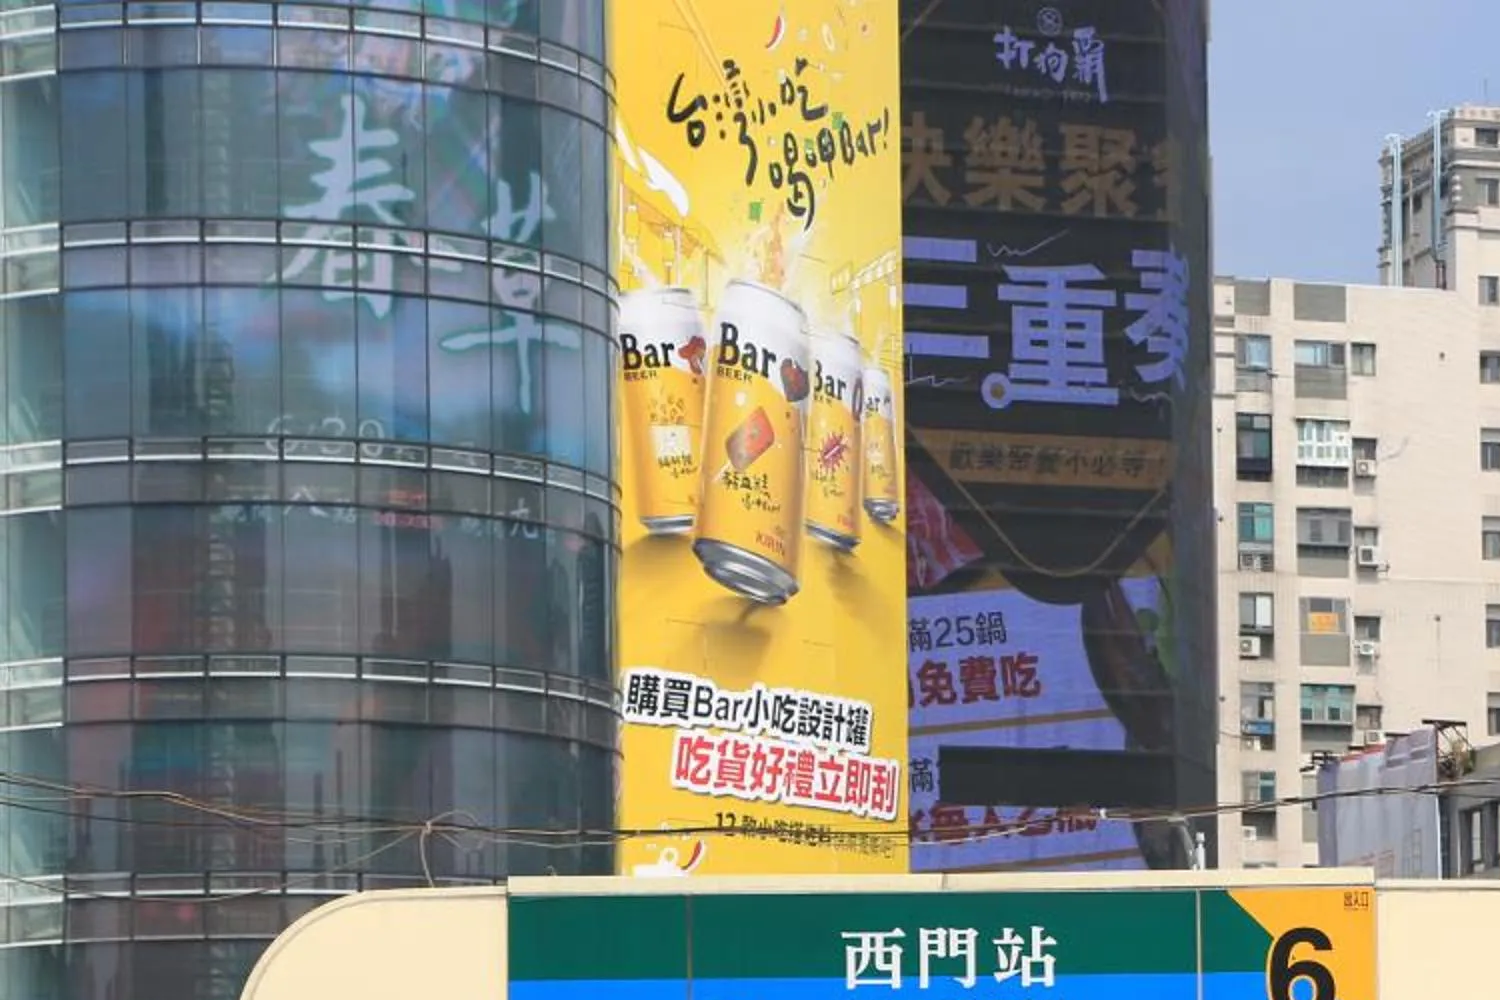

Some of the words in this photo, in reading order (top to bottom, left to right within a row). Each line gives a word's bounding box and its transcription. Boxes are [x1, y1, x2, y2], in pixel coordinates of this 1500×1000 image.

[619, 333, 675, 370] Bar
[717, 322, 776, 378] Bar
[909, 651, 1041, 709] 免費吃
[626, 674, 870, 748] 購買Bar小吃設計罐
[675, 737, 898, 814] 吃貨好禮立即刮
[840, 926, 1058, 990] 西門站
